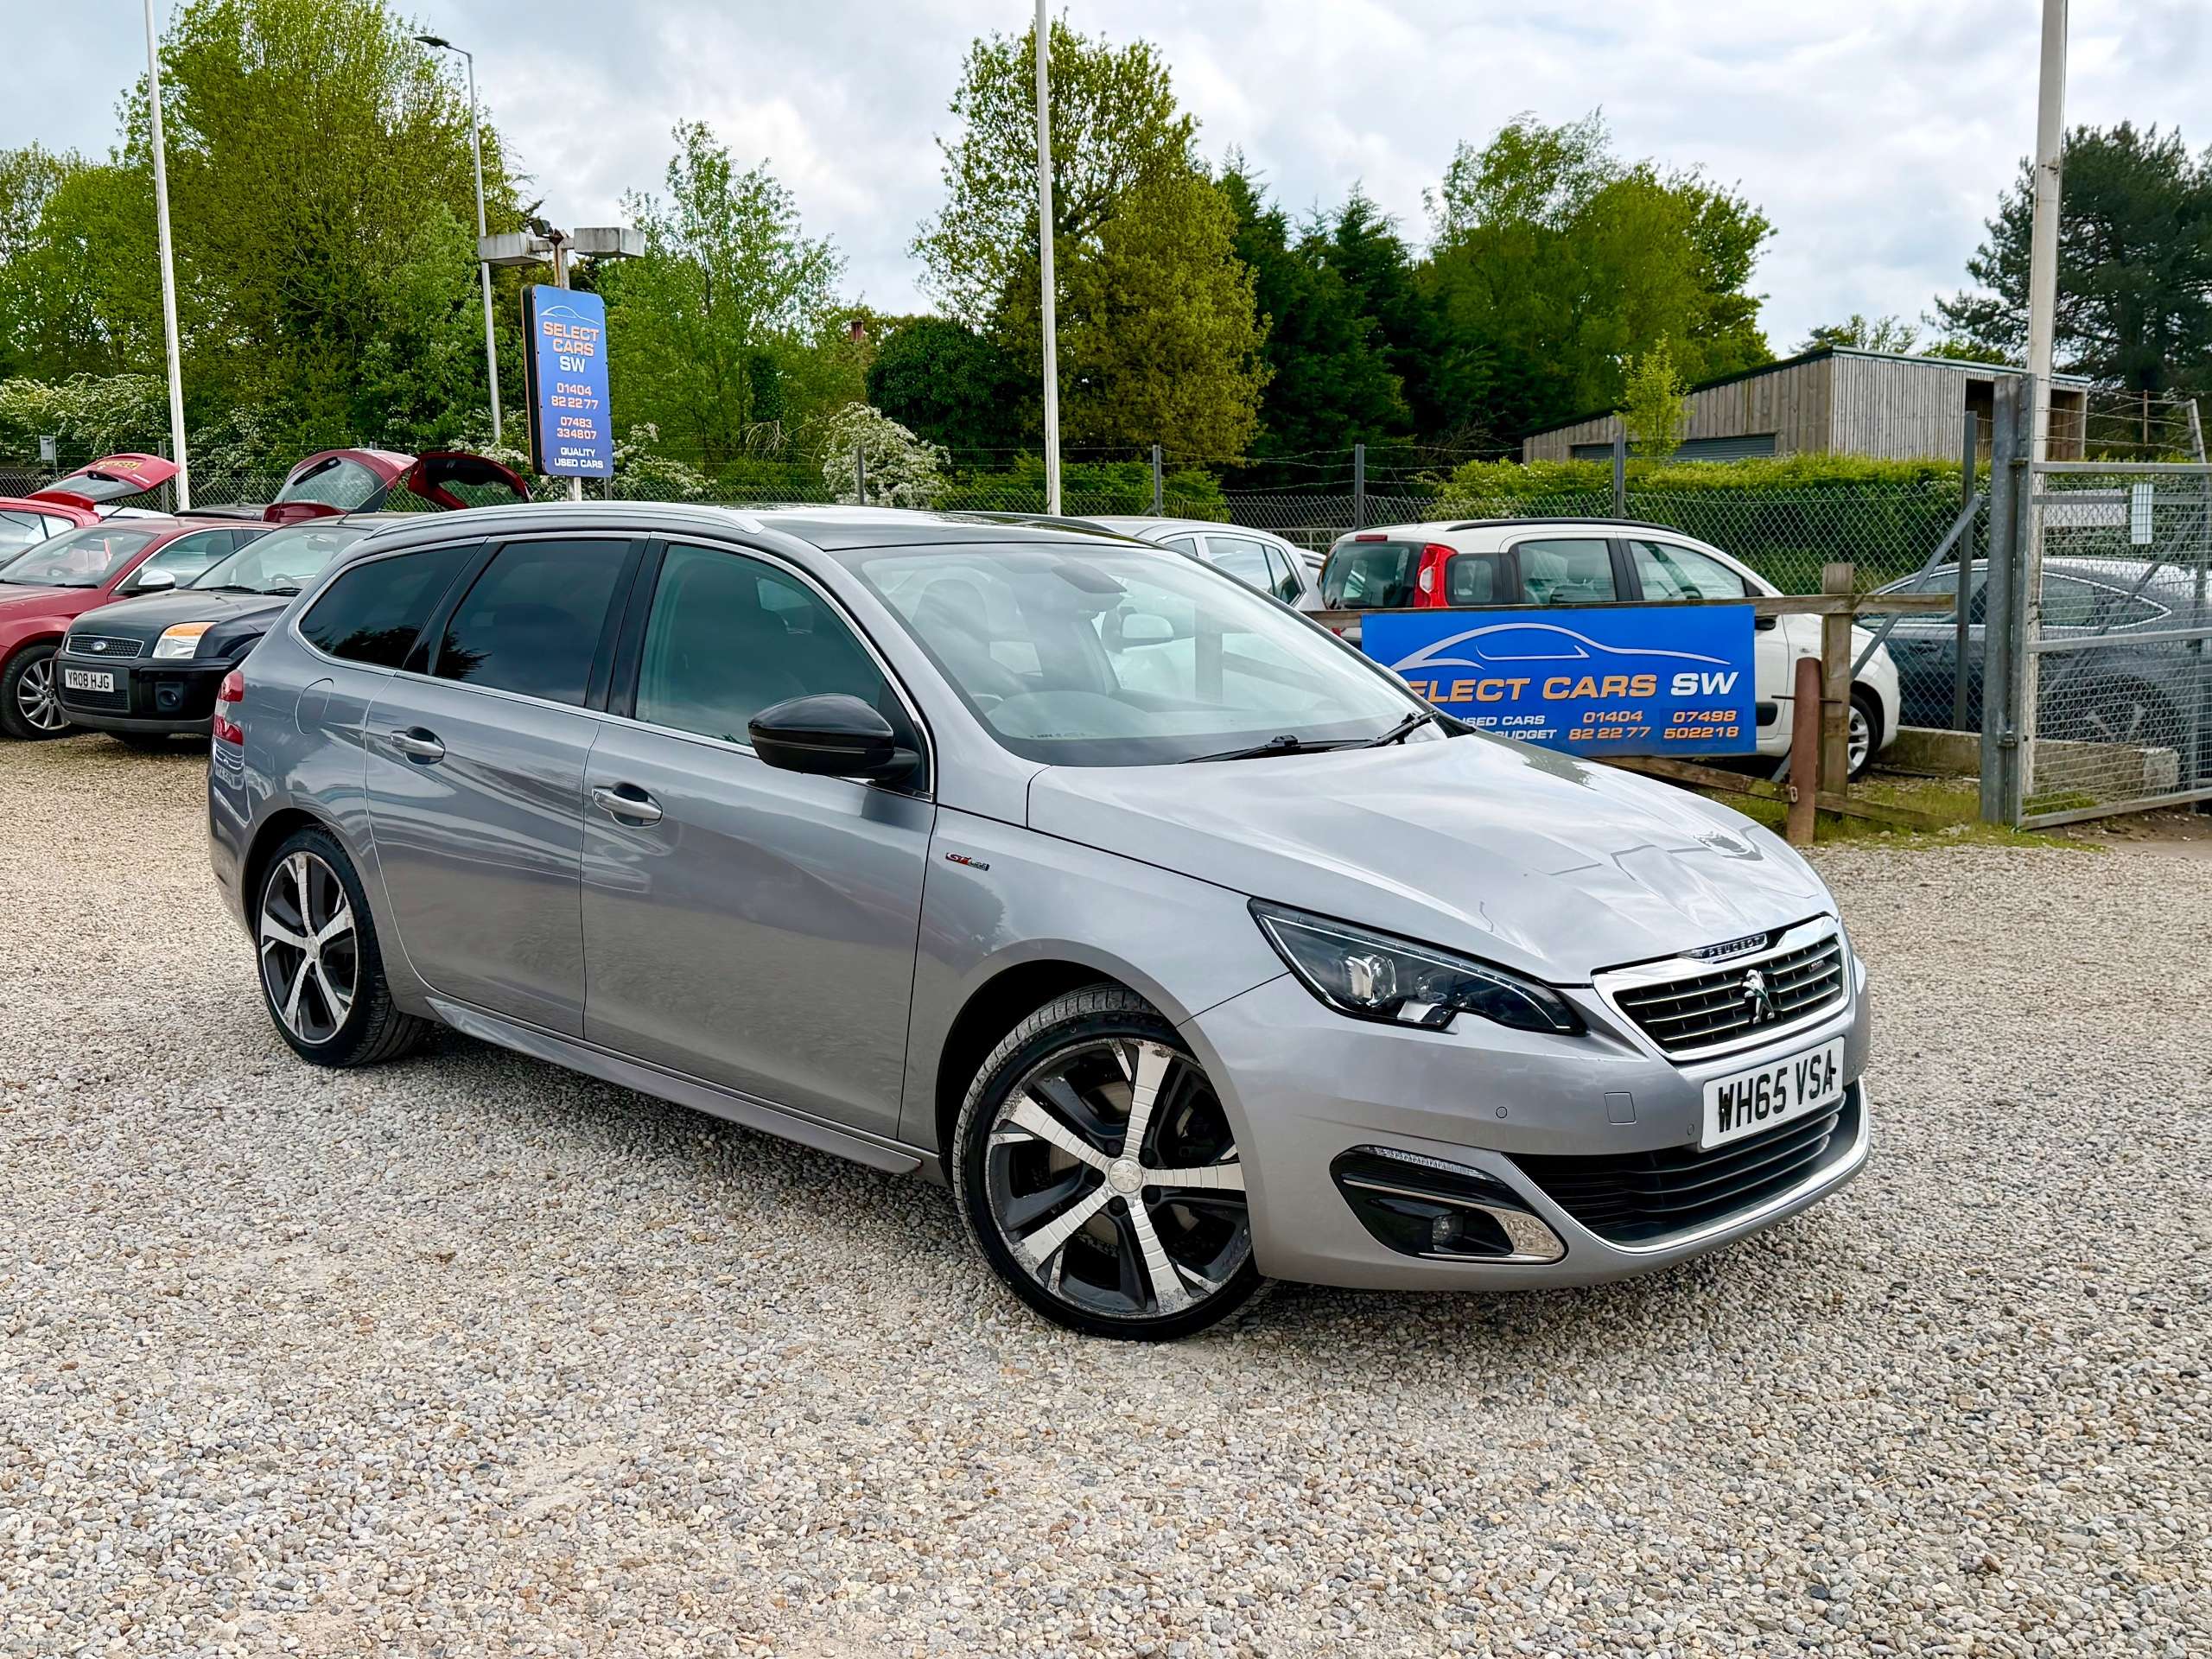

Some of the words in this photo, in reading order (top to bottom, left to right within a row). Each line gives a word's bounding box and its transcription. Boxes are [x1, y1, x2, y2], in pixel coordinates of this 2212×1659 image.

[543, 321, 600, 342] SELECT
[553, 338, 594, 357] CARS
[559, 355, 586, 373] SW
[556, 382, 592, 397] 01404
[551, 395, 567, 407] 82
[568, 397, 583, 409] 22
[584, 398, 599, 410] 77
[560, 416, 593, 429] 07483
[556, 428, 597, 440] 334807
[560, 447, 596, 457] QUALITY
[554, 458, 578, 467] USED
[580, 459, 604, 469] CARS
[68, 671, 88, 687] YR08
[91, 674, 110, 689] HJG
[1408, 678, 1530, 702] ELECT
[1542, 674, 1657, 701] CARS
[1670, 671, 1739, 696] SW
[1502, 715, 1545, 727] CARS
[1582, 710, 1643, 724] 01404
[1673, 709, 1737, 724] 07498
[1568, 728, 1593, 741] 82
[1597, 728, 1622, 740] 22
[1627, 726, 1651, 739] 77
[1663, 726, 1739, 740] 502218
[1708, 937, 1760, 957] PEUGEOT
[1718, 1066, 1788, 1133] WH65
[1796, 1049, 1837, 1106] VSA
